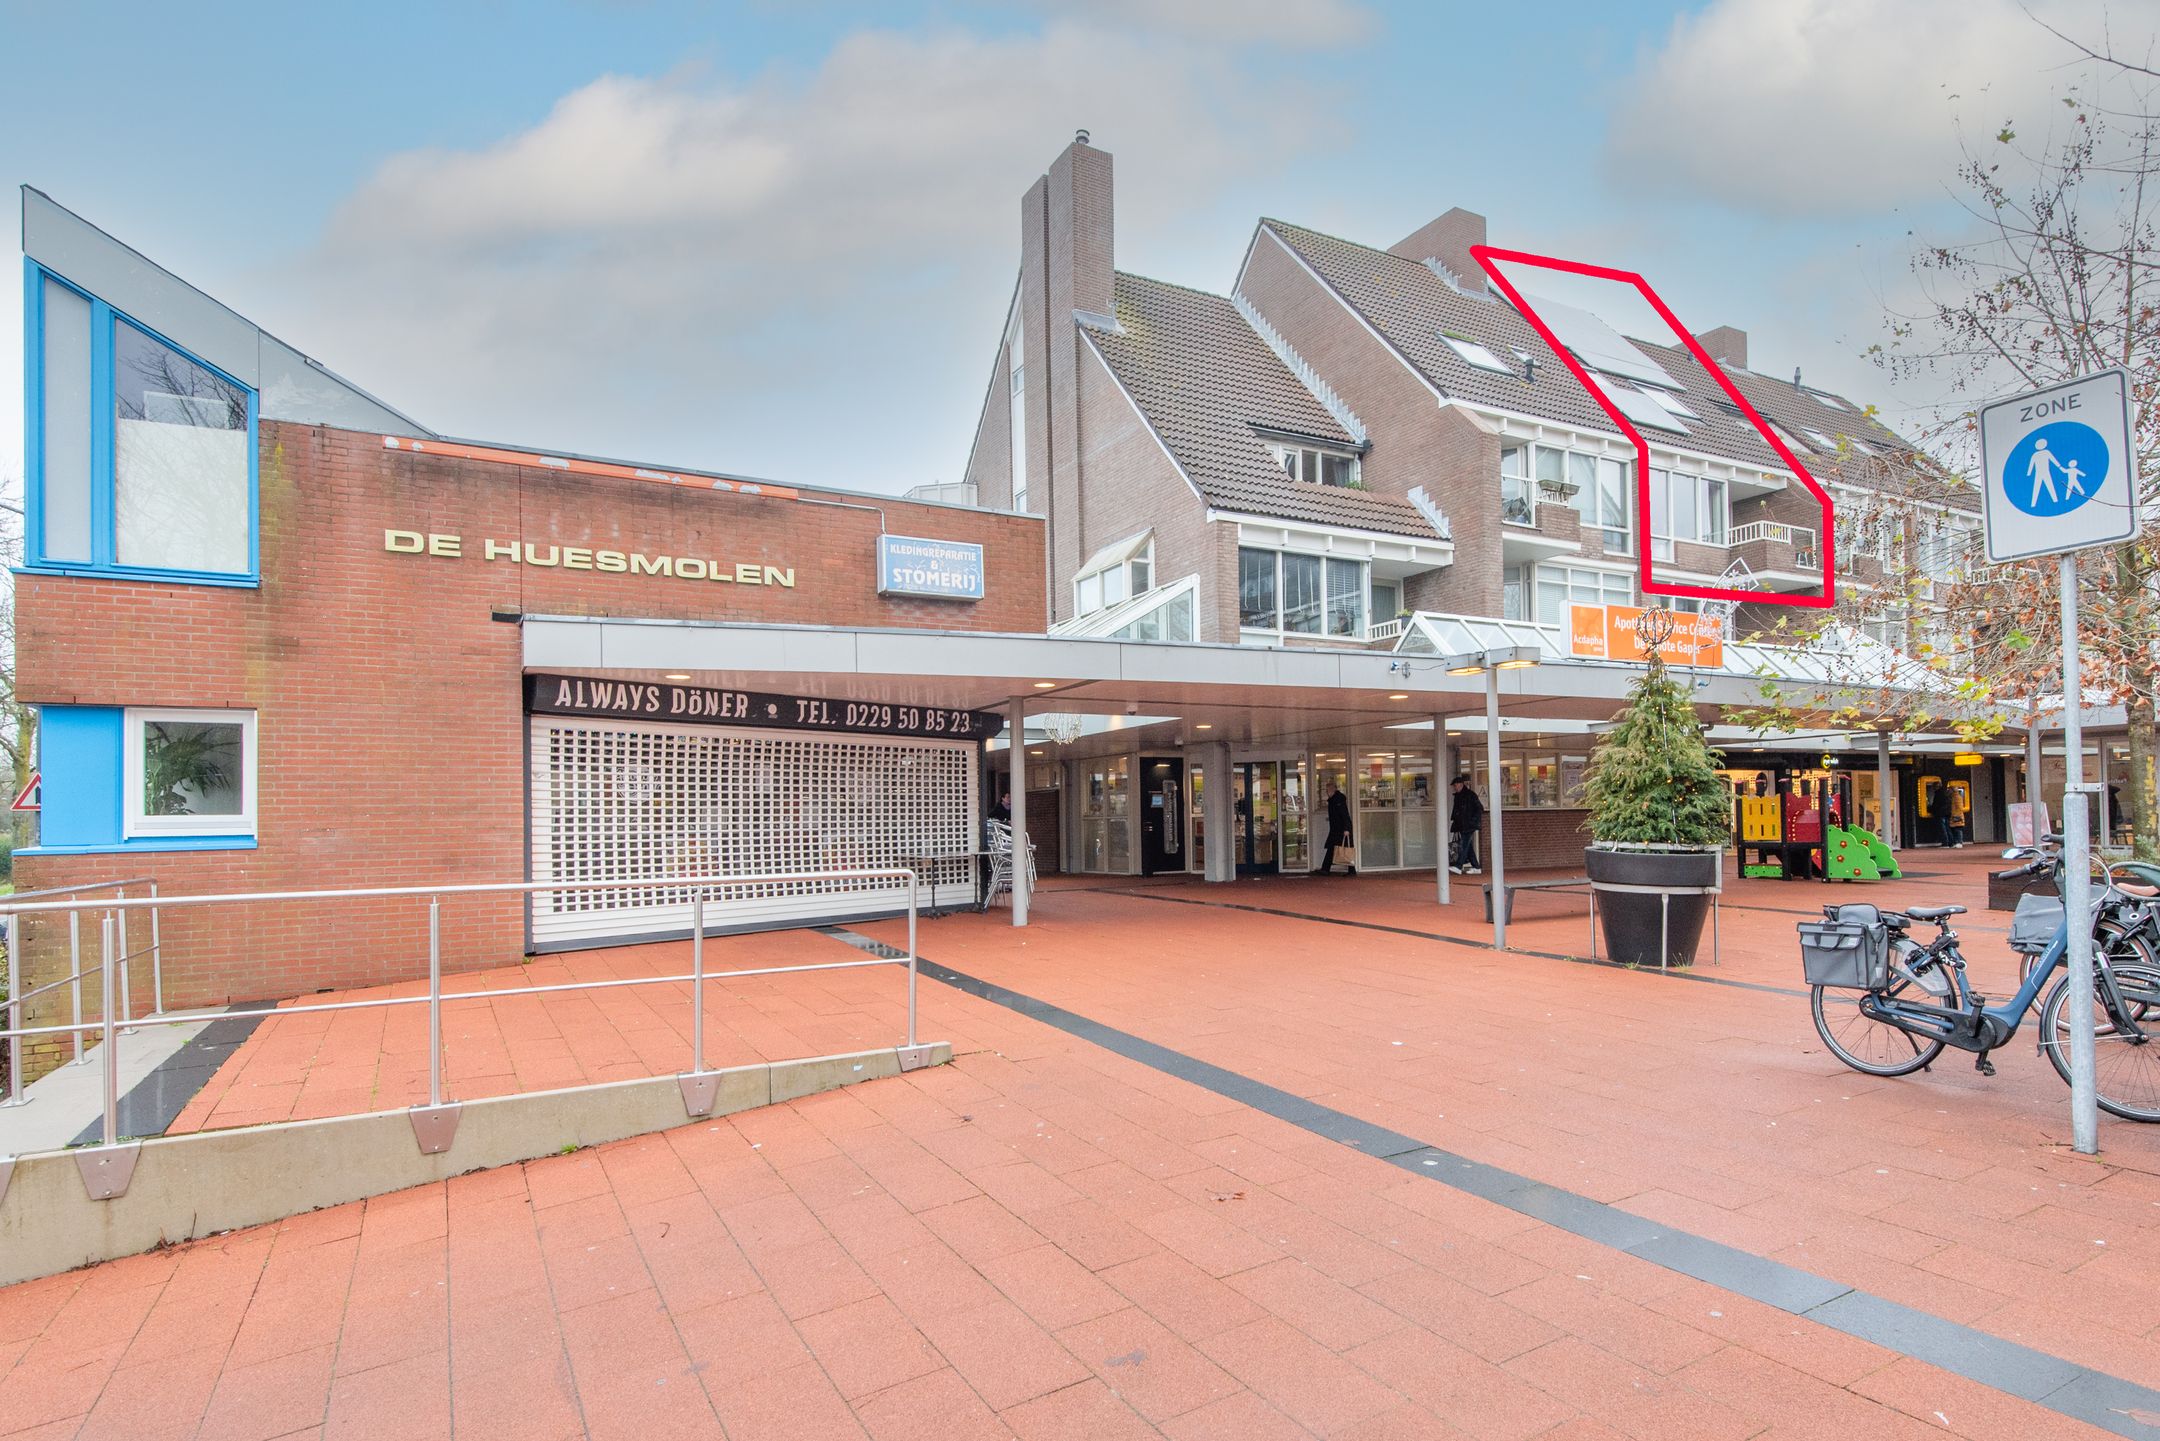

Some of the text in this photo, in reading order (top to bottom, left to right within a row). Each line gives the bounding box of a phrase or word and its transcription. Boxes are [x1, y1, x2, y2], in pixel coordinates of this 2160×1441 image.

[2020, 393, 2082, 422] ZONE
[385, 529, 797, 588] DE HUESMOLEN
[890, 543, 977, 561] KLEDINGREPARATIE
[931, 560, 939, 570] &
[893, 568, 976, 592] STOMERIJ
[1657, 619, 1688, 635] Svice
[1634, 635, 1645, 649] De
[1677, 640, 1701, 656] Gapr
[554, 679, 660, 713] ALWAYS
[797, 700, 836, 725] TEL.
[846, 703, 891, 728] 0229
[898, 707, 918, 729] 50
[925, 709, 945, 732] 85
[950, 711, 970, 733] 23
